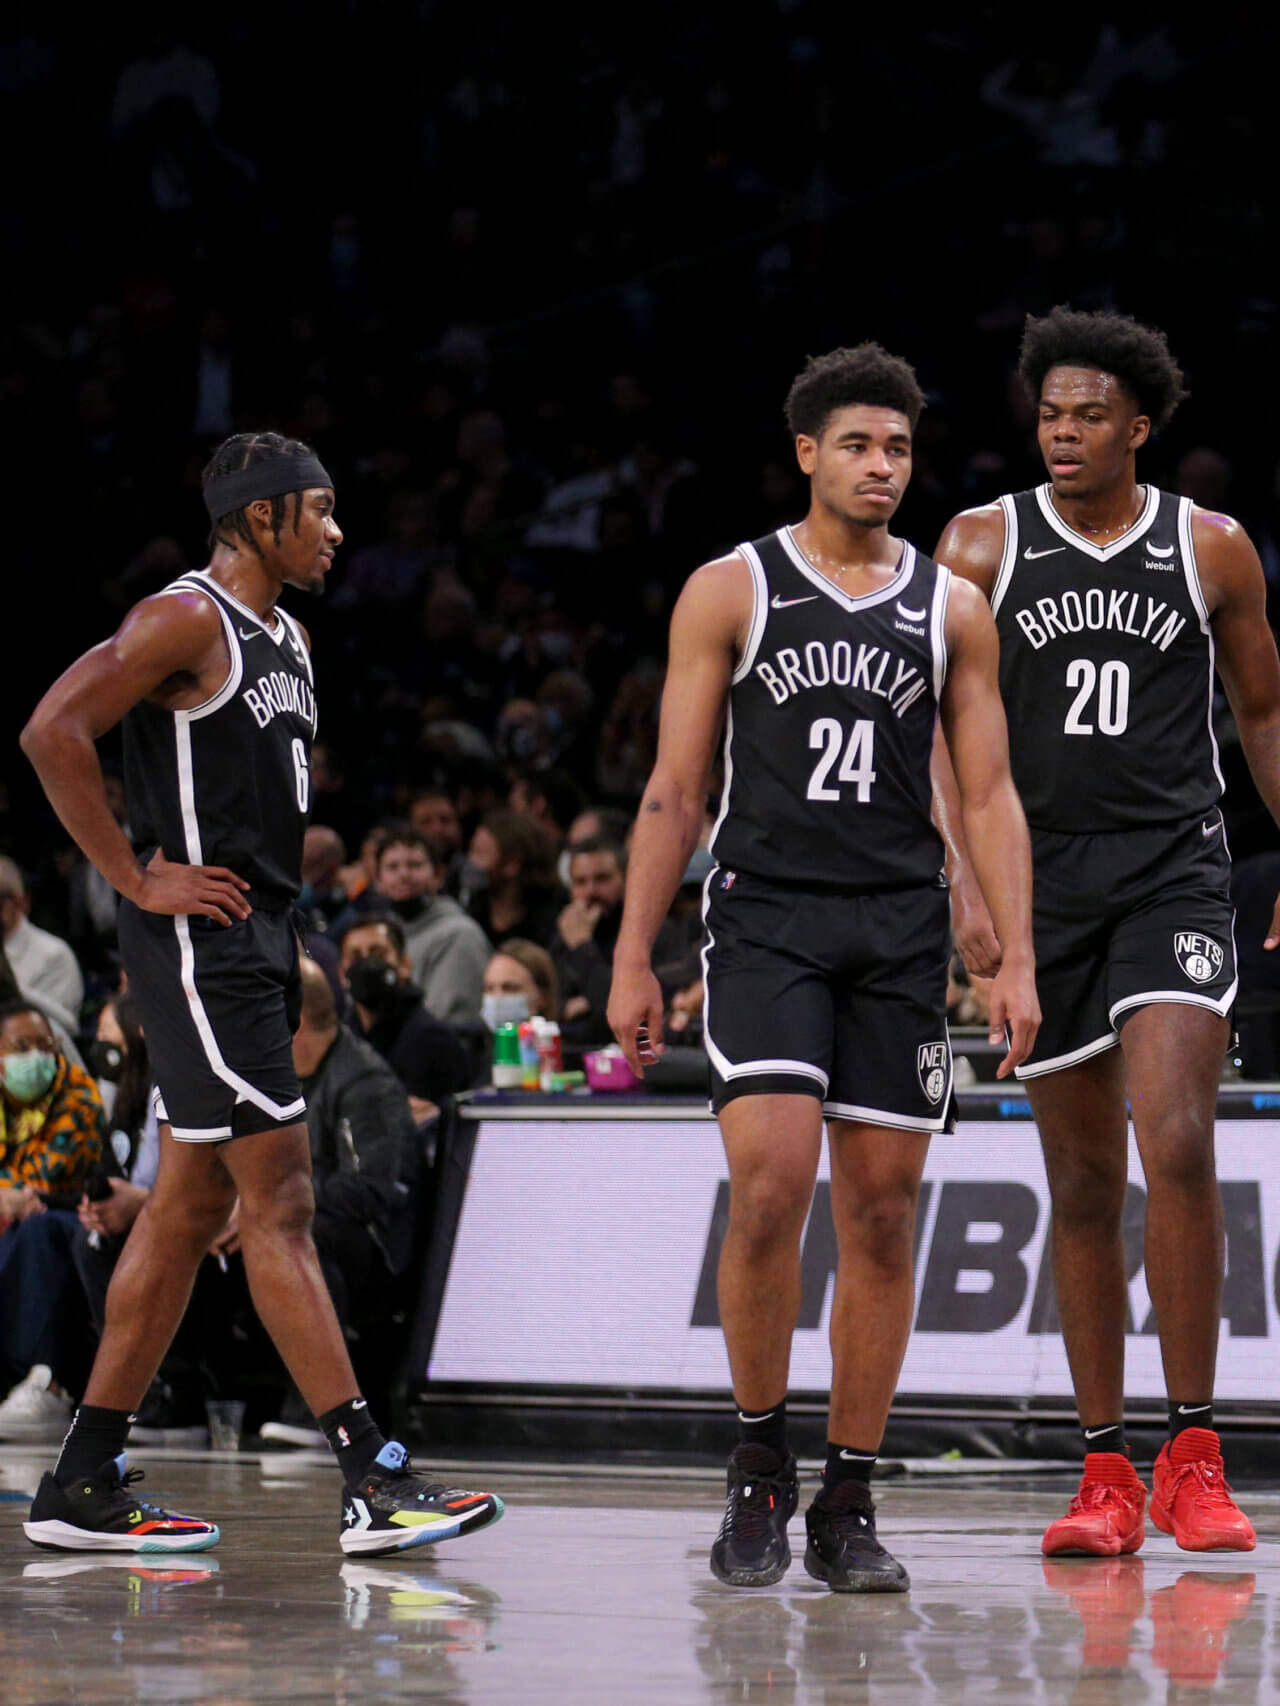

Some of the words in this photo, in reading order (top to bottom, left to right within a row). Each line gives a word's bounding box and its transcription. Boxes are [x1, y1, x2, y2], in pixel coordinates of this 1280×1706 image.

[1145, 560, 1175, 572] Webull
[895, 620, 926, 637] Webull
[1015, 588, 1187, 652] BROOKLYN
[756, 640, 927, 718] BROOKLYN
[1064, 658, 1130, 736] 20
[292, 738, 309, 813] 6
[807, 718, 876, 802] 24
[1178, 935, 1221, 966] NETS
